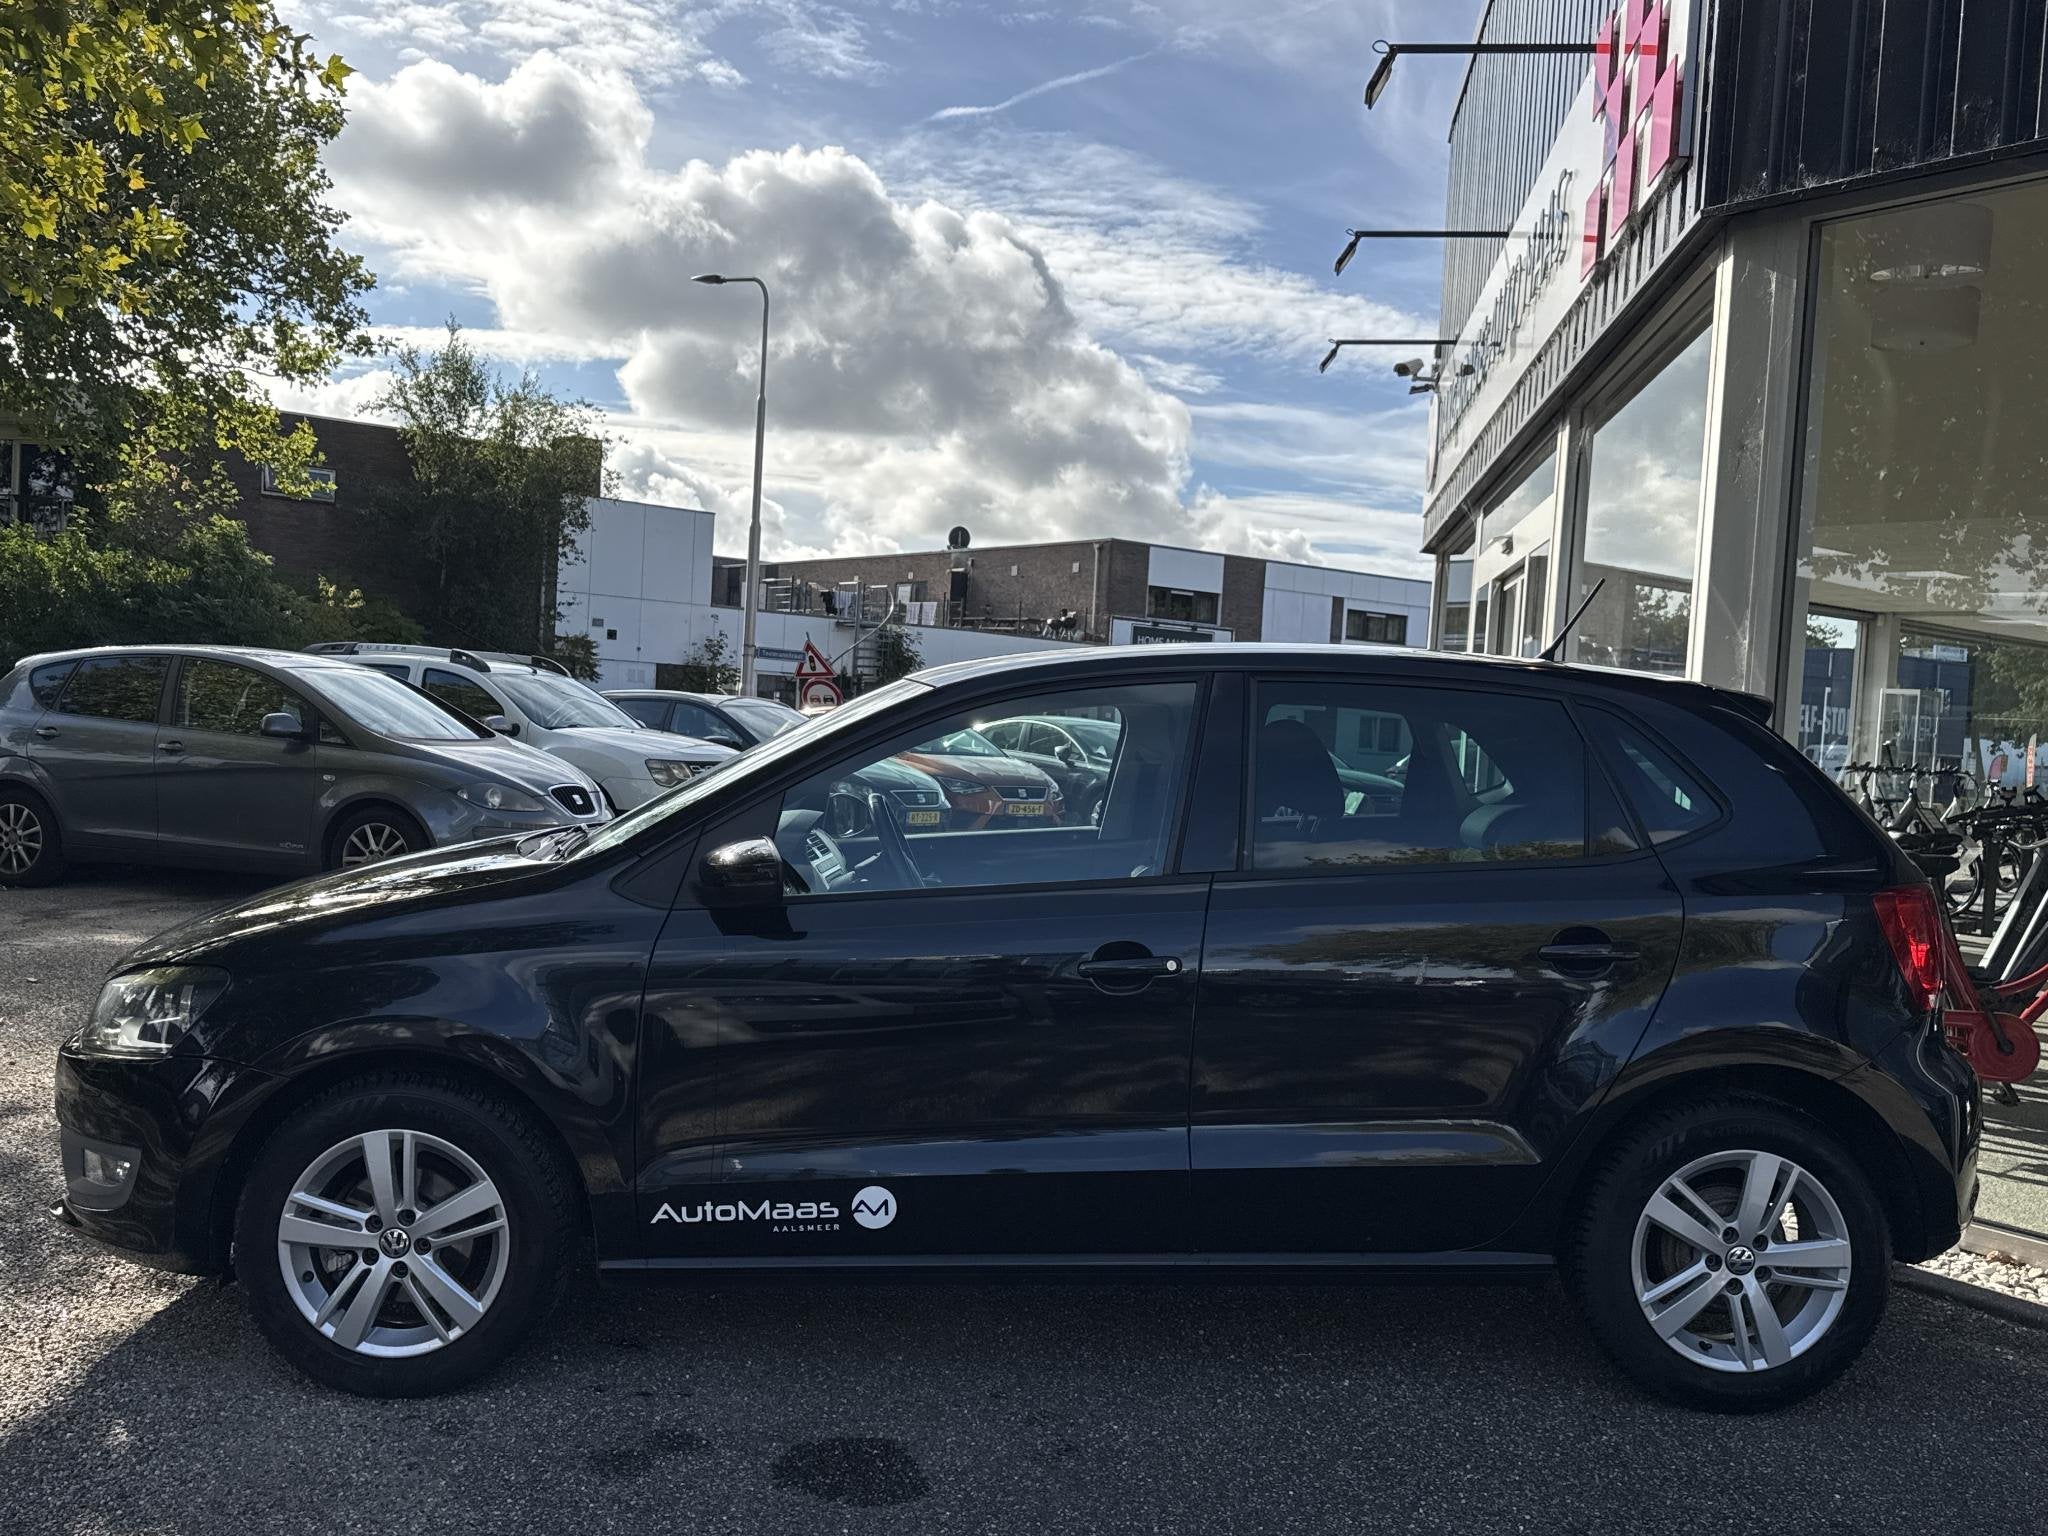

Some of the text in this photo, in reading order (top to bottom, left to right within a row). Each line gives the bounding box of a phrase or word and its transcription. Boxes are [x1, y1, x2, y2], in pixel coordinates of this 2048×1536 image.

[1799, 704, 1850, 736] ELF-STO
[650, 1200, 839, 1224] AutoMaas
[773, 1224, 840, 1233] AALSMEER
